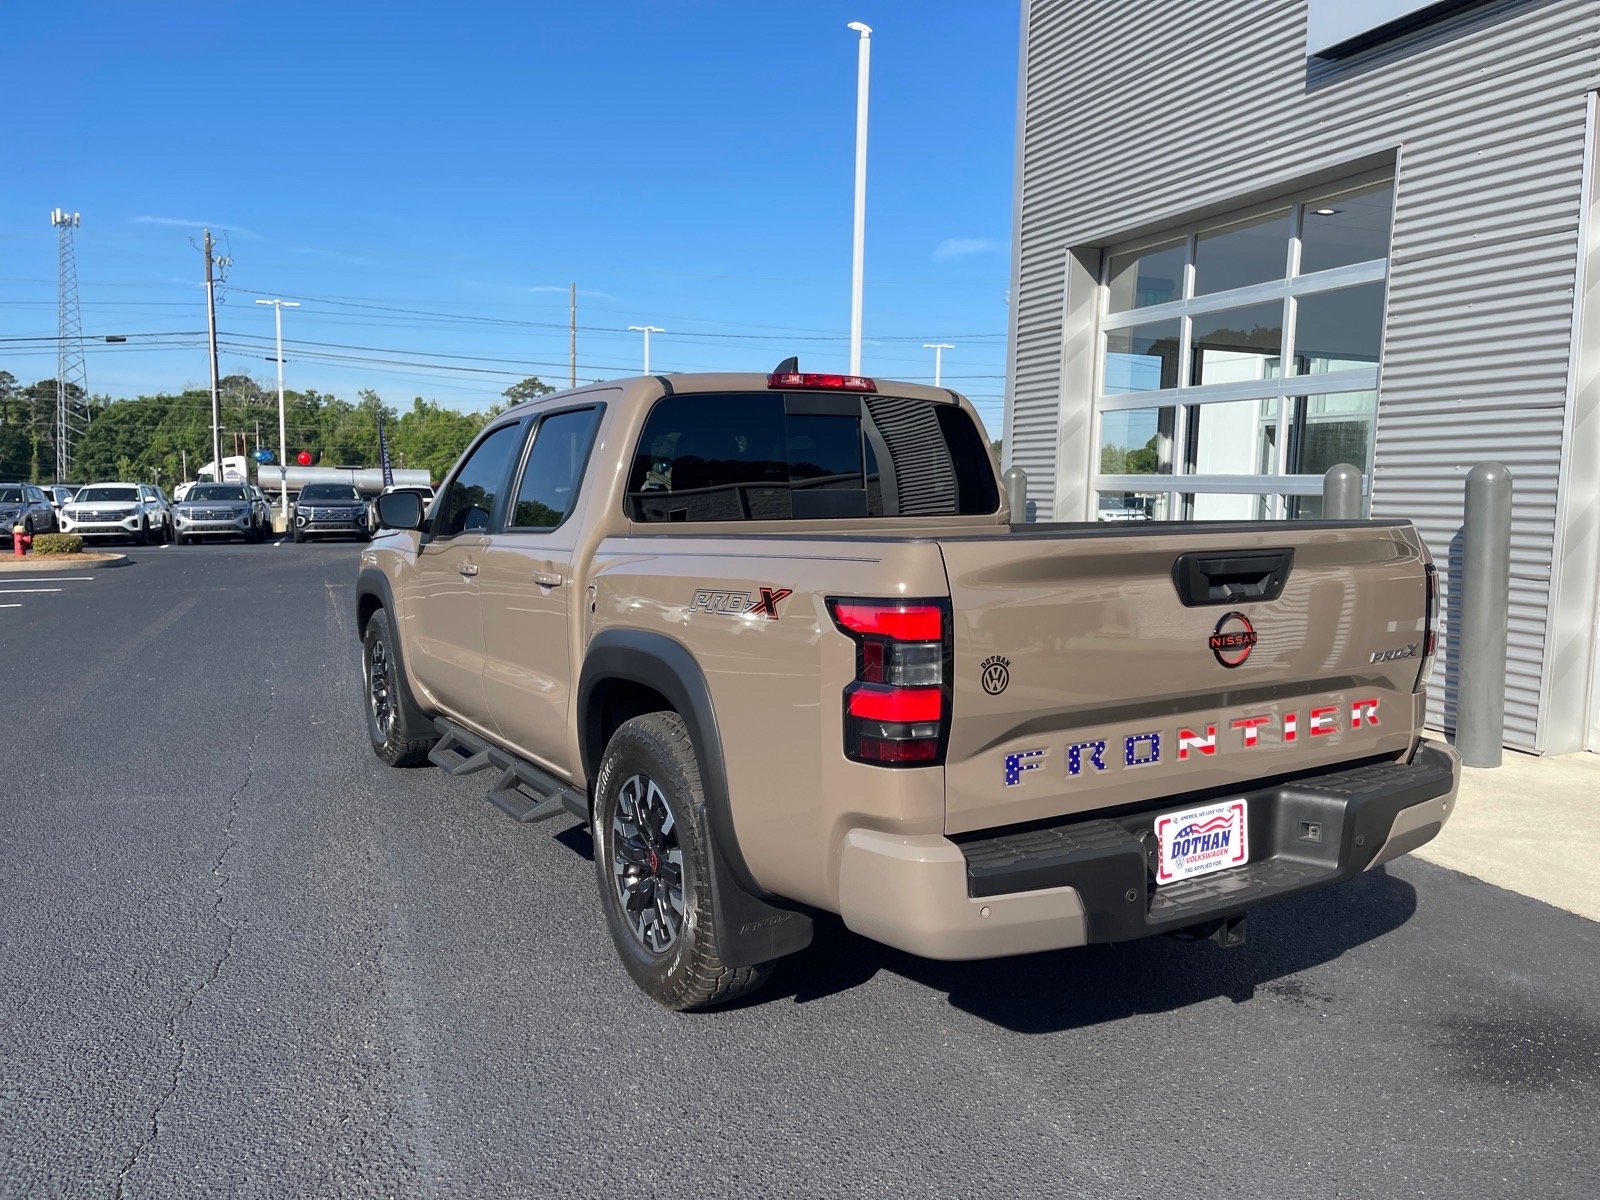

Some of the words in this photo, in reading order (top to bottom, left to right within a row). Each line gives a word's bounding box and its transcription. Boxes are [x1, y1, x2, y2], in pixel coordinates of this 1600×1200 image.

[1211, 634, 1257, 647] NISSAN
[980, 655, 1011, 669] DOTHAN
[1003, 697, 1382, 787] FRONTIER
[1170, 829, 1231, 860] DOTHAN
[1185, 848, 1229, 864] VOLKSWAGEN
[1193, 862, 1212, 872] APPLIED
[1212, 859, 1222, 867] FOR
